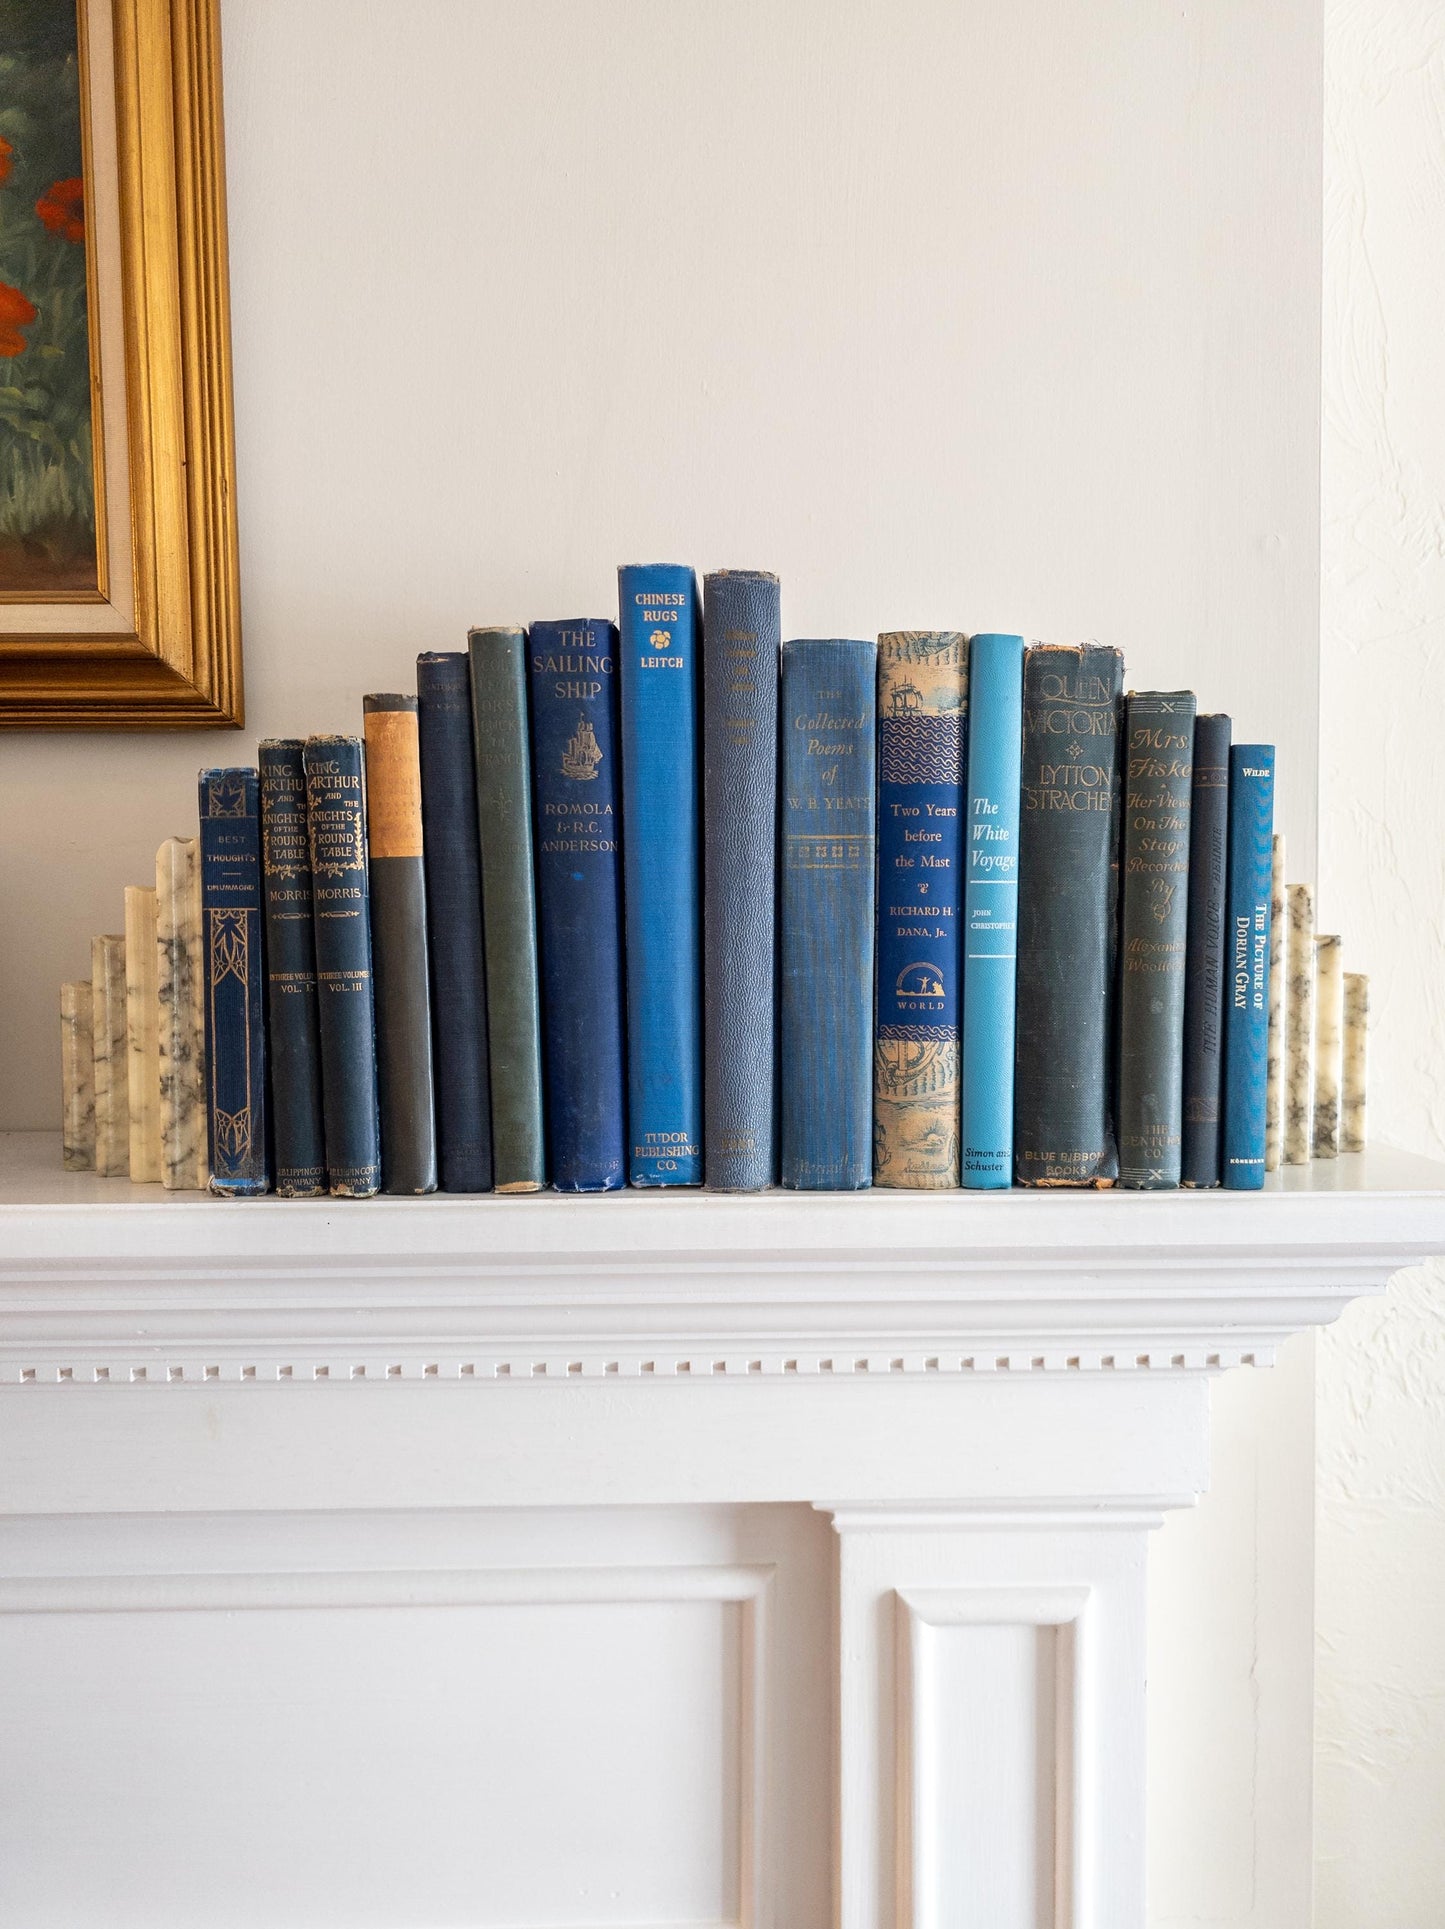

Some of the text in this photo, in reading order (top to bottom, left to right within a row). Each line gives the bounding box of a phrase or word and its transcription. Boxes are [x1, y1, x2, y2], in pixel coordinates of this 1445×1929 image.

[635, 593, 686, 606] CHINESE
[644, 610, 678, 622] RUGS
[558, 630, 597, 647] THE
[533, 656, 614, 674] SAILING
[641, 657, 684, 668] LEITCH
[554, 682, 602, 699] SHIP
[1040, 675, 1112, 706] QUEEN
[795, 712, 866, 730] Collected
[1027, 710, 1117, 735] VICTORIA
[807, 739, 854, 756] Poems
[261, 764, 293, 777] KING
[308, 760, 340, 774] KING
[1129, 757, 1192, 778] Fiske
[821, 765, 838, 786] of
[1040, 765, 1113, 787] LYTTON
[262, 779, 304, 792] ARTHU
[309, 776, 360, 789] ARTHUR
[824, 797, 872, 810] YEATS
[973, 798, 999, 815] The
[1027, 790, 1116, 812] STRACHEY
[1127, 791, 1192, 809] Her Views
[309, 811, 354, 821] KNIGHTS
[545, 803, 613, 816] ROMOLA
[890, 803, 957, 817] Two Years
[262, 813, 306, 824] KNIGHTS
[1134, 816, 1186, 832] On The
[557, 821, 570, 833] &
[972, 824, 1010, 841] White
[218, 835, 245, 843] BEST
[271, 836, 307, 846] ROUND
[318, 833, 354, 844] ROUND
[904, 830, 942, 842] before
[321, 846, 352, 857] TABLE
[541, 839, 619, 852] ANDERSON
[1139, 838, 1185, 858] Stage
[207, 854, 256, 862] THOUGHTS
[273, 849, 305, 859] TABLE
[895, 855, 950, 868] the Mast
[971, 850, 1017, 872] Voyage
[270, 890, 313, 901] MORRIS
[317, 888, 361, 899] MORRIS
[1151, 878, 1178, 904] By
[890, 906, 954, 916] RICHARD H.
[972, 909, 992, 918] JOHN
[1255, 903, 1267, 931] THE
[1206, 900, 1220, 949] VOICE
[897, 928, 932, 937] DANA,
[1234, 916, 1250, 1010] DORIAN GRAY
[1253, 935, 1267, 989] PICTURE
[281, 985, 302, 993] VOL.
[329, 982, 363, 992] VOL. III
[1204, 954, 1218, 1016] HUMAN
[897, 1002, 945, 1010] WORLD
[1202, 1020, 1217, 1056] THE
[645, 1132, 688, 1143] TUDOR
[635, 1144, 700, 1157] PUBLISHING
[965, 1147, 994, 1158] Simon
[1025, 1151, 1057, 1161] BLUE
[656, 1159, 678, 1171] CO.
[965, 1160, 1003, 1171] Schuster
[1046, 1165, 1087, 1175] BOOKS
